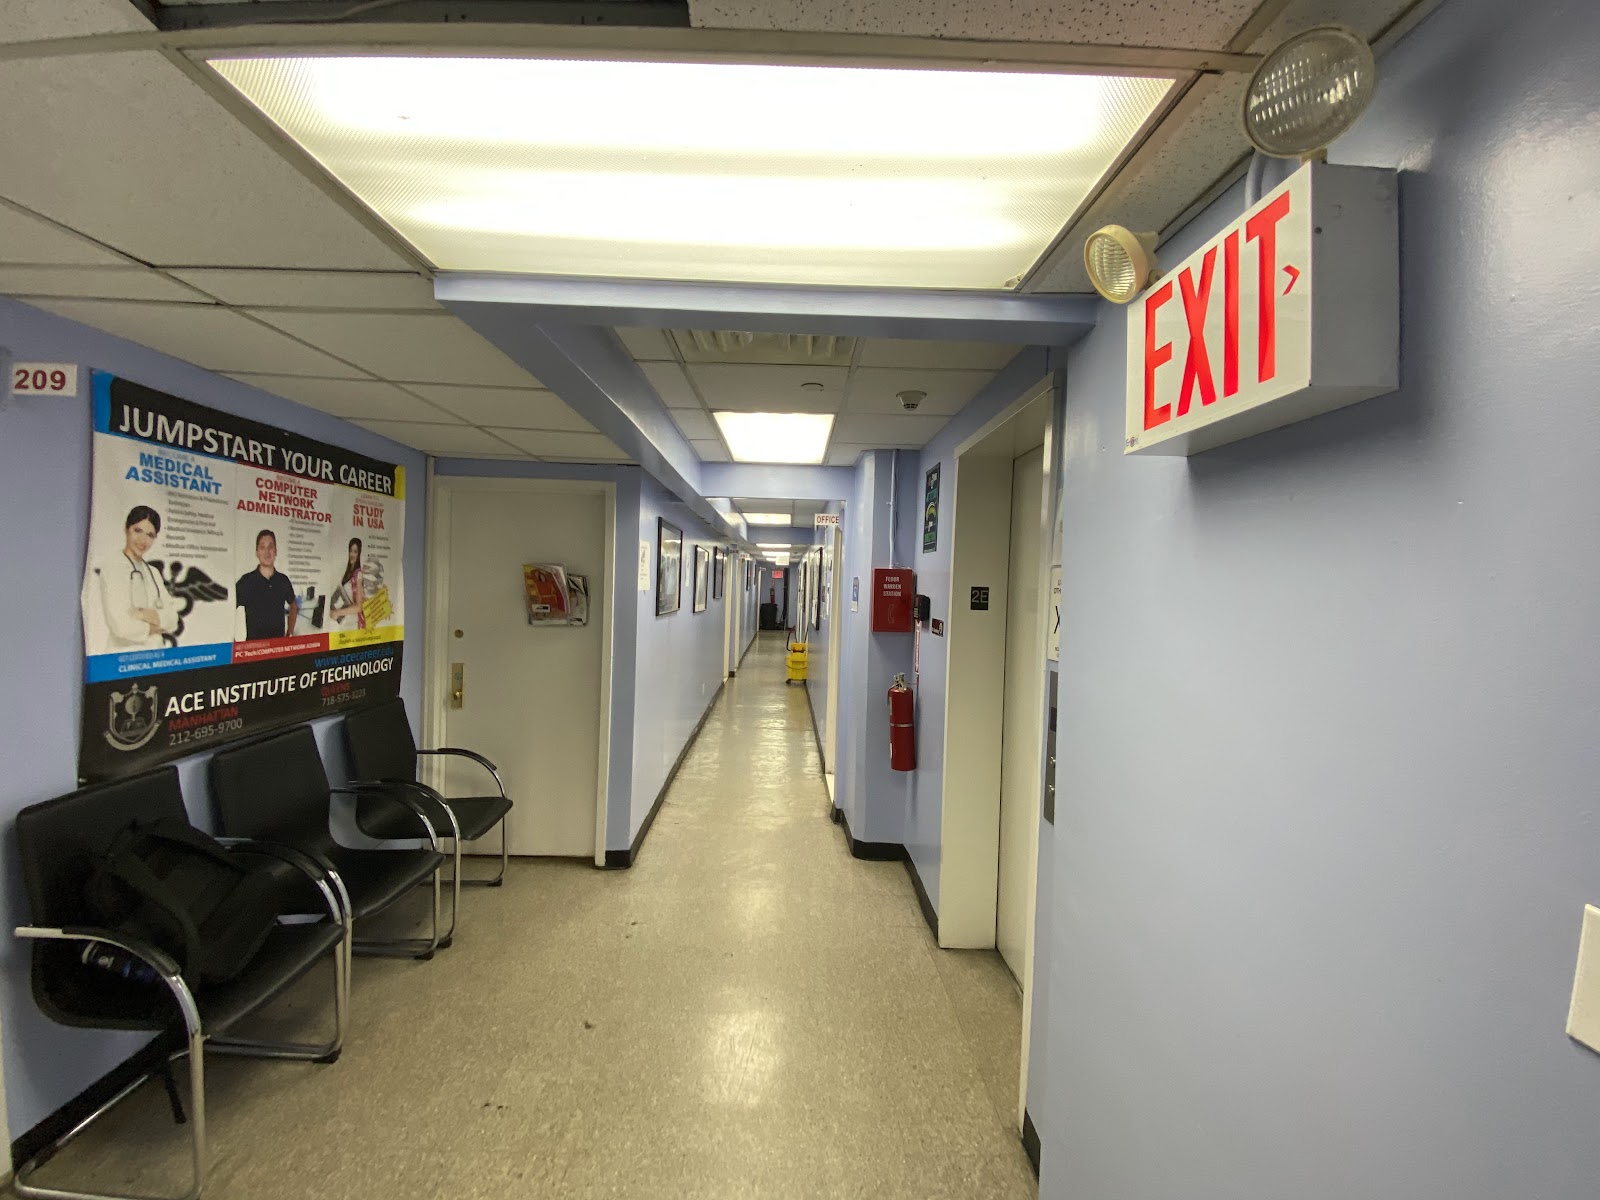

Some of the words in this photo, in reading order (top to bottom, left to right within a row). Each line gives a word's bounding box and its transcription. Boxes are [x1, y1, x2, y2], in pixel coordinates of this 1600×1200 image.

[1144, 190, 1290, 431] EXIT
[15, 369, 66, 391] 209
[119, 404, 276, 467] JUMPSTART
[281, 447, 335, 481] YOUR
[339, 464, 392, 495] CAREER
[139, 452, 213, 480] MEDICAL
[125, 466, 222, 495] ASSISTANT
[255, 477, 318, 500] COMPUTER
[236, 499, 332, 523] ADMINISTRATOR
[258, 490, 315, 510] NETWORK
[353, 503, 385, 519] STUDY
[353, 515, 364, 527] IN
[367, 517, 385, 530] USA
[816, 515, 840, 524] OFFICE
[971, 589, 988, 603] 2E
[235, 651, 244, 659] PC
[284, 643, 306, 652] NETWORK
[118, 660, 152, 673] CLINICAL
[152, 658, 182, 668] MEDICAL
[183, 654, 217, 664] ASSISTANT
[165, 691, 205, 717] ACE
[210, 675, 297, 708] INSTITUTE
[299, 671, 318, 690] OF
[321, 657, 394, 685] TECHNOLOGY
[168, 705, 239, 731] MANHATTAN
[169, 717, 243, 746] 212-695-9700
